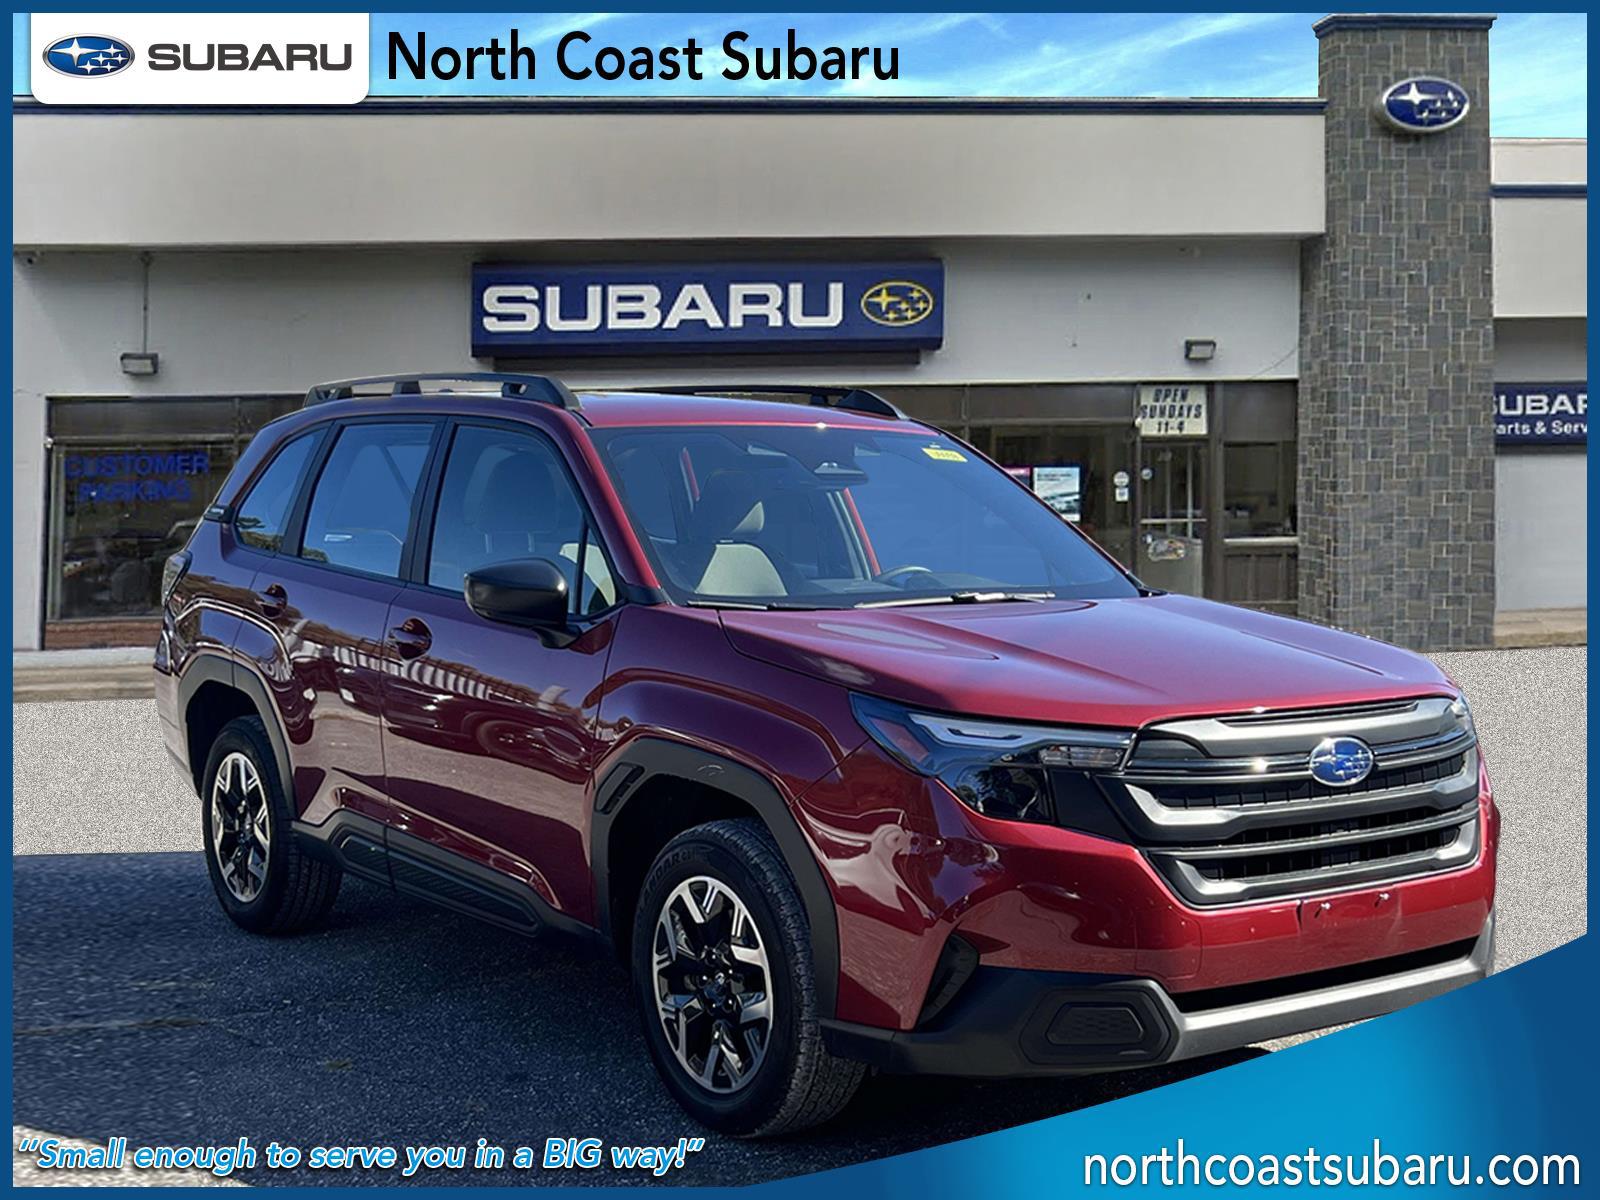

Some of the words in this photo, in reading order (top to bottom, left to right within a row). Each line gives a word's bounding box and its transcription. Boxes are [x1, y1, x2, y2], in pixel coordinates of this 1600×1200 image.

[482, 282, 844, 332] SUBARU
[1153, 388, 1189, 403] OPEN
[1492, 394, 1587, 415] UBA
[1140, 404, 1202, 420] SUNDAYS
[1535, 421, 1546, 434] &
[64, 452, 209, 480] CUSTOMER
[78, 479, 191, 503] PARKING
